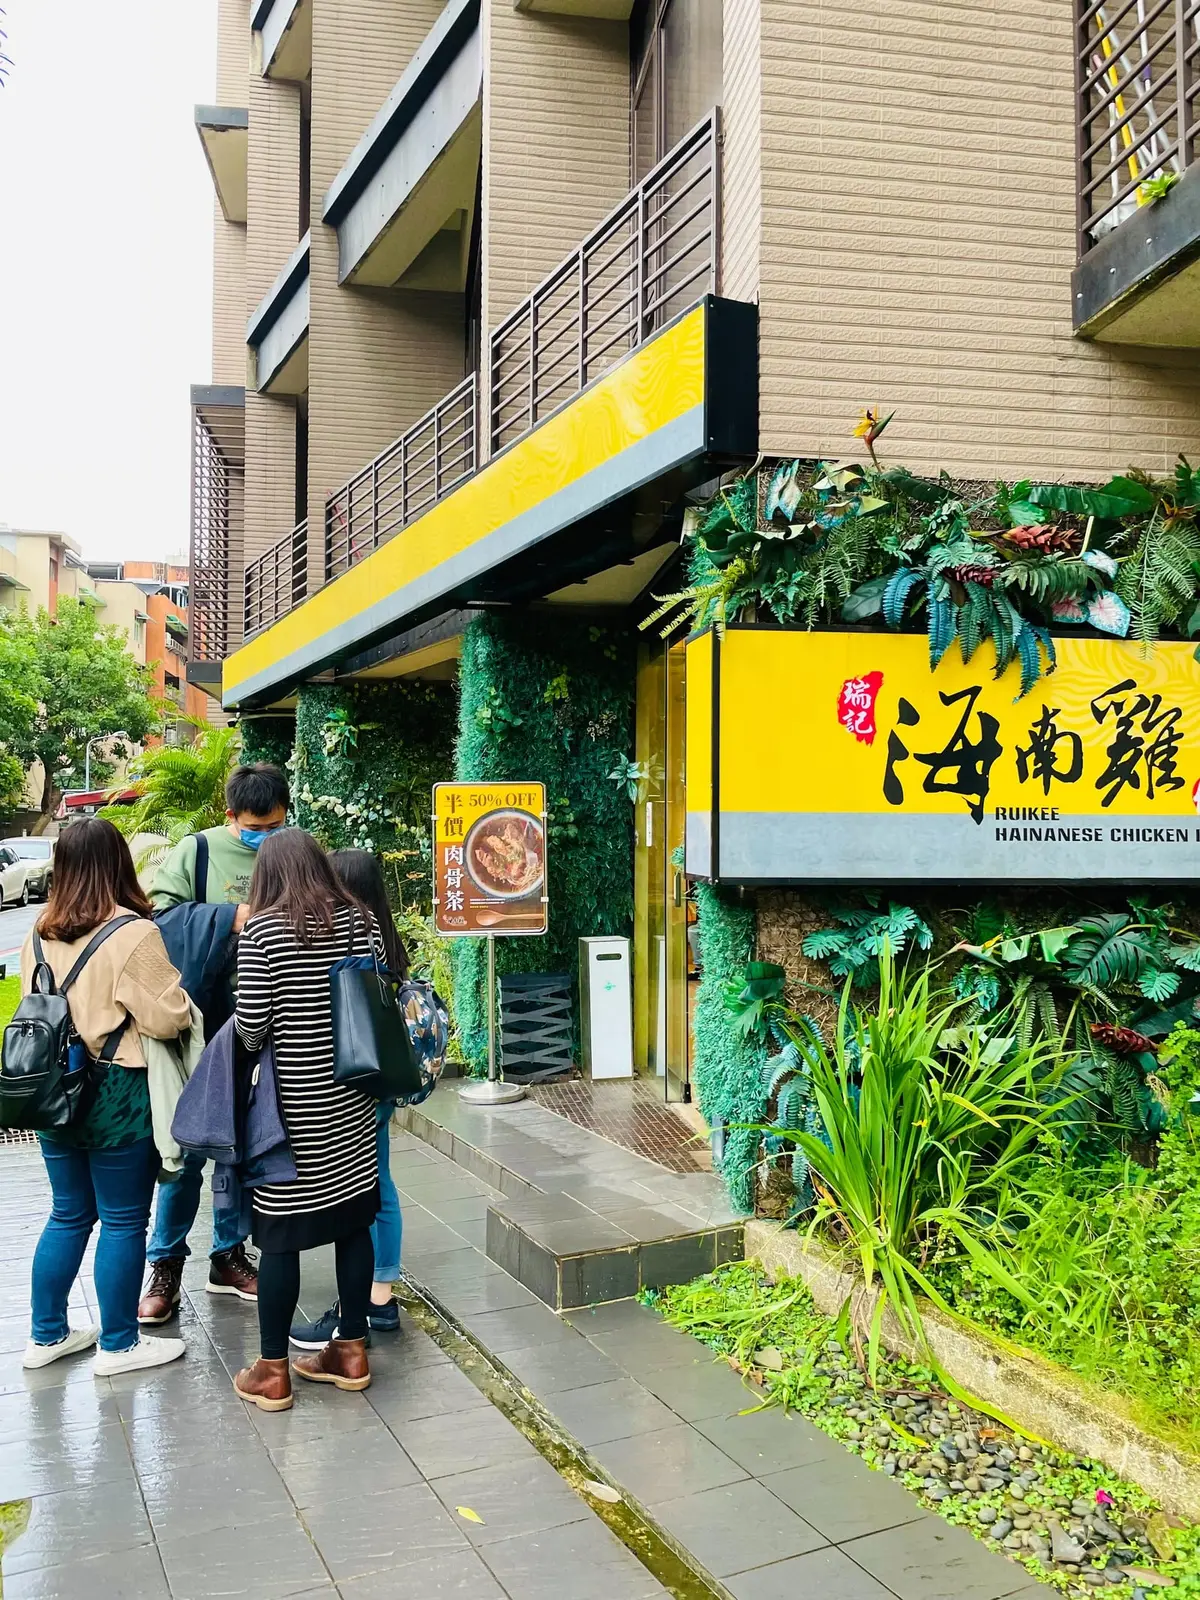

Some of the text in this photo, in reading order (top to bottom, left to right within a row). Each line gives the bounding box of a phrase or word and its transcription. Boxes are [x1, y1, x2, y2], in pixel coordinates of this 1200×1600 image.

[842, 678, 873, 734] 瑞記
[468, 792, 537, 807] 50% OFF
[995, 806, 1060, 821] RUIKEE
[443, 793, 464, 837] 半價
[995, 827, 1103, 842] HAINANESE
[1110, 827, 1189, 842] CHICKEN
[443, 844, 465, 912] 肉骨茶
